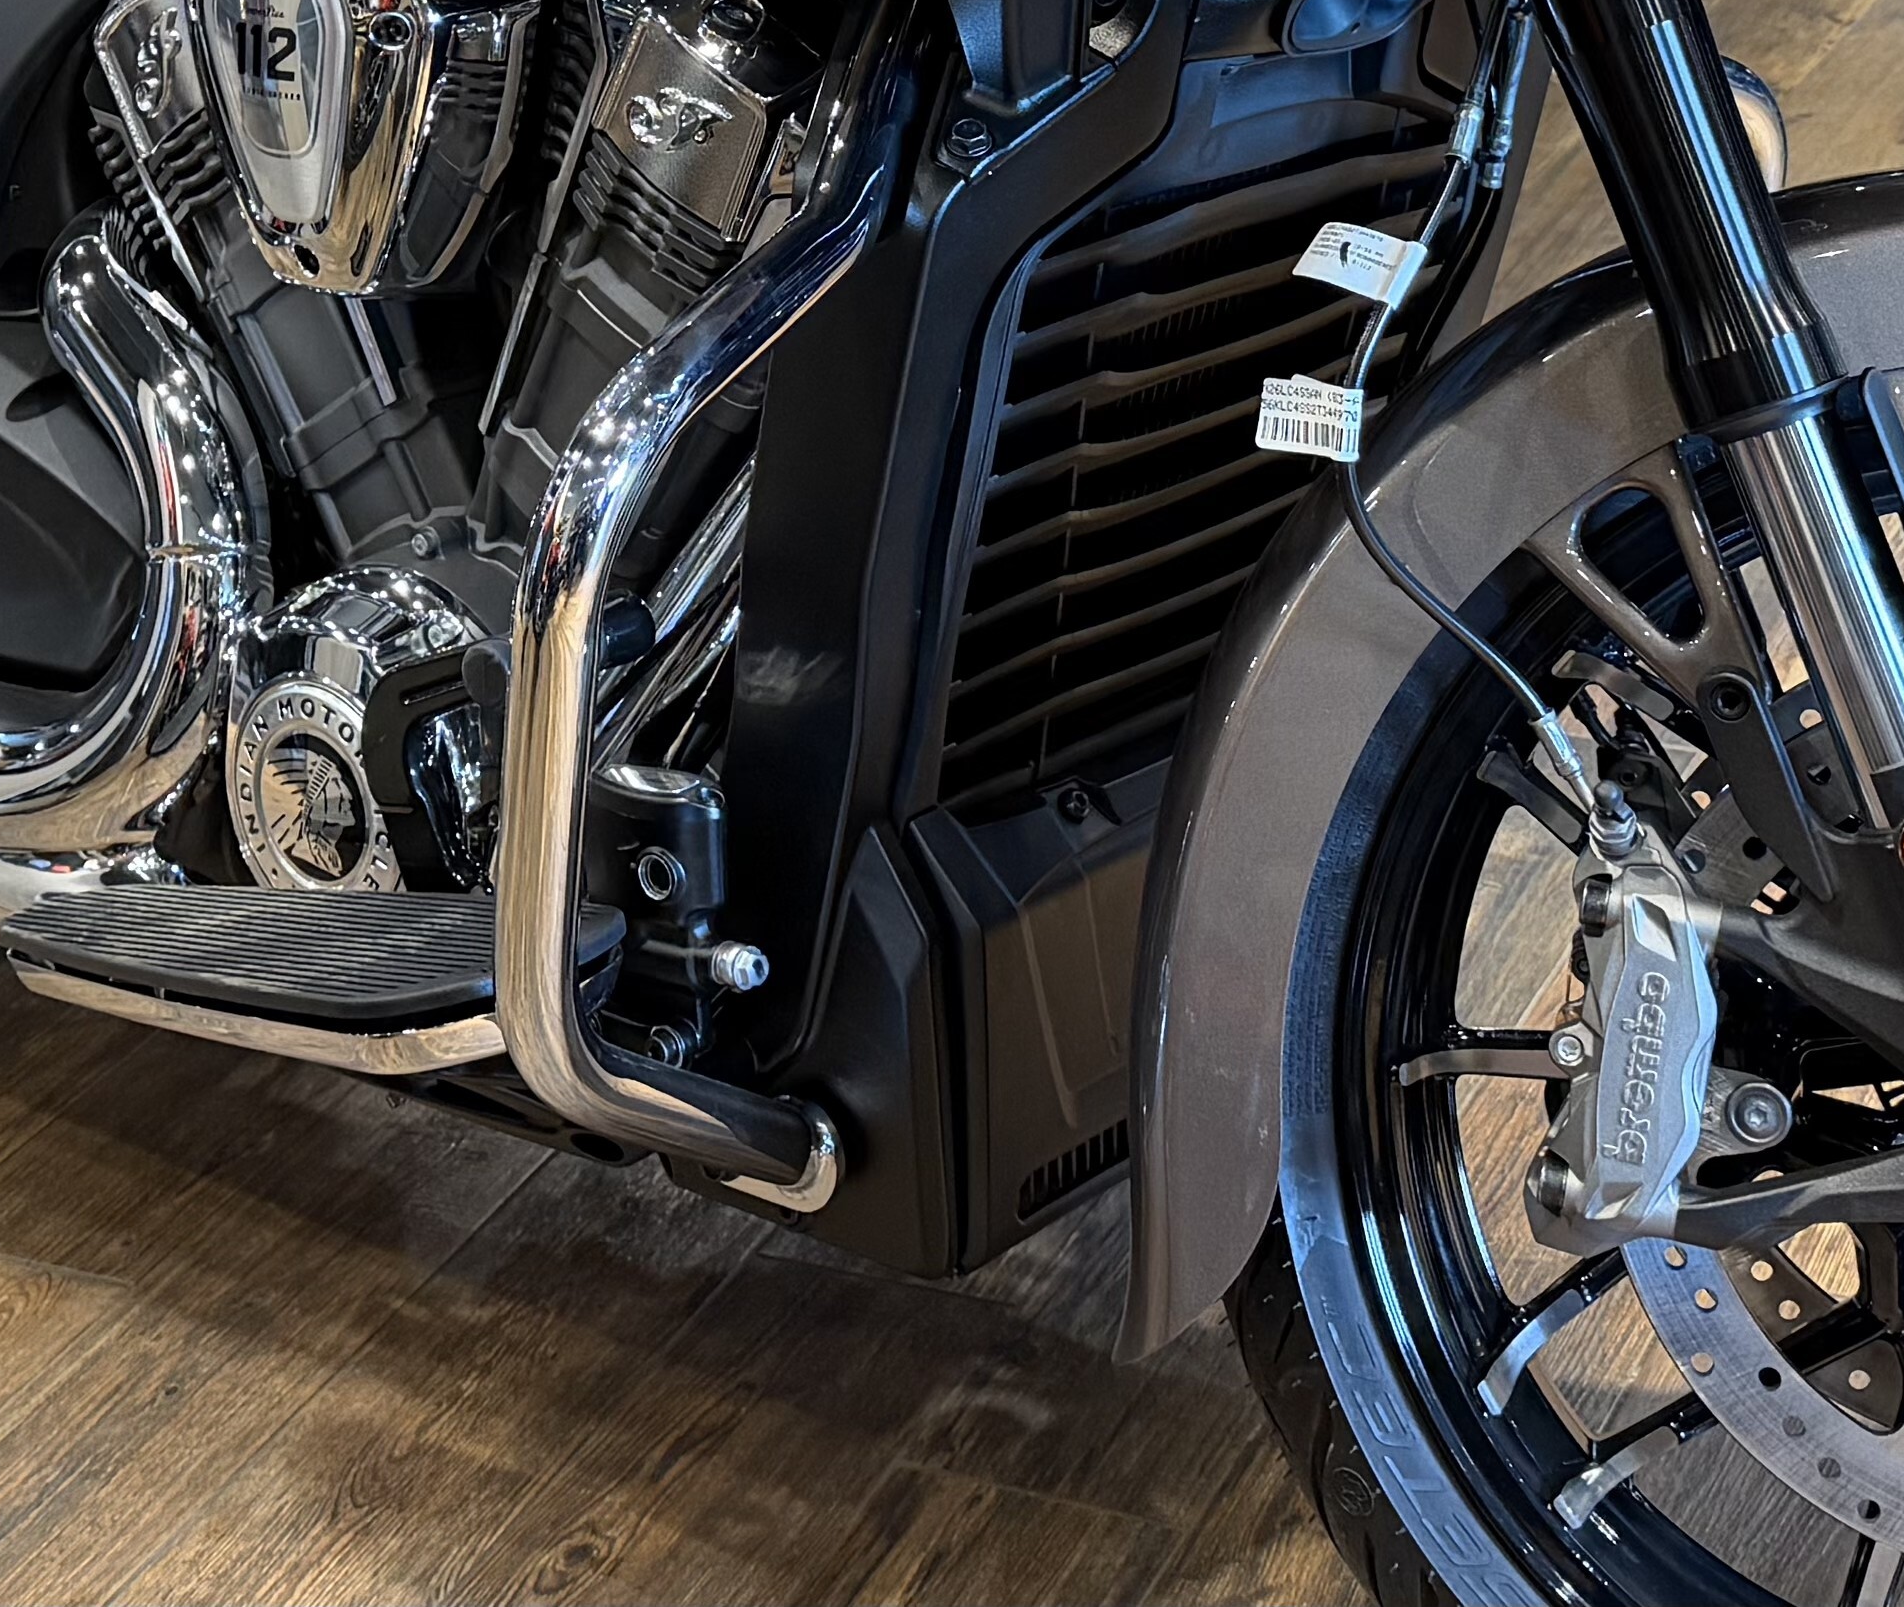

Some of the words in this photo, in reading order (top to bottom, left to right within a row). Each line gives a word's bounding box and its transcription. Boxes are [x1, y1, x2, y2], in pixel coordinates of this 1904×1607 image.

[236, 21, 297, 82] 112
[240, 714, 269, 853] INDIAN
[1601, 970, 1671, 1165] brembo
